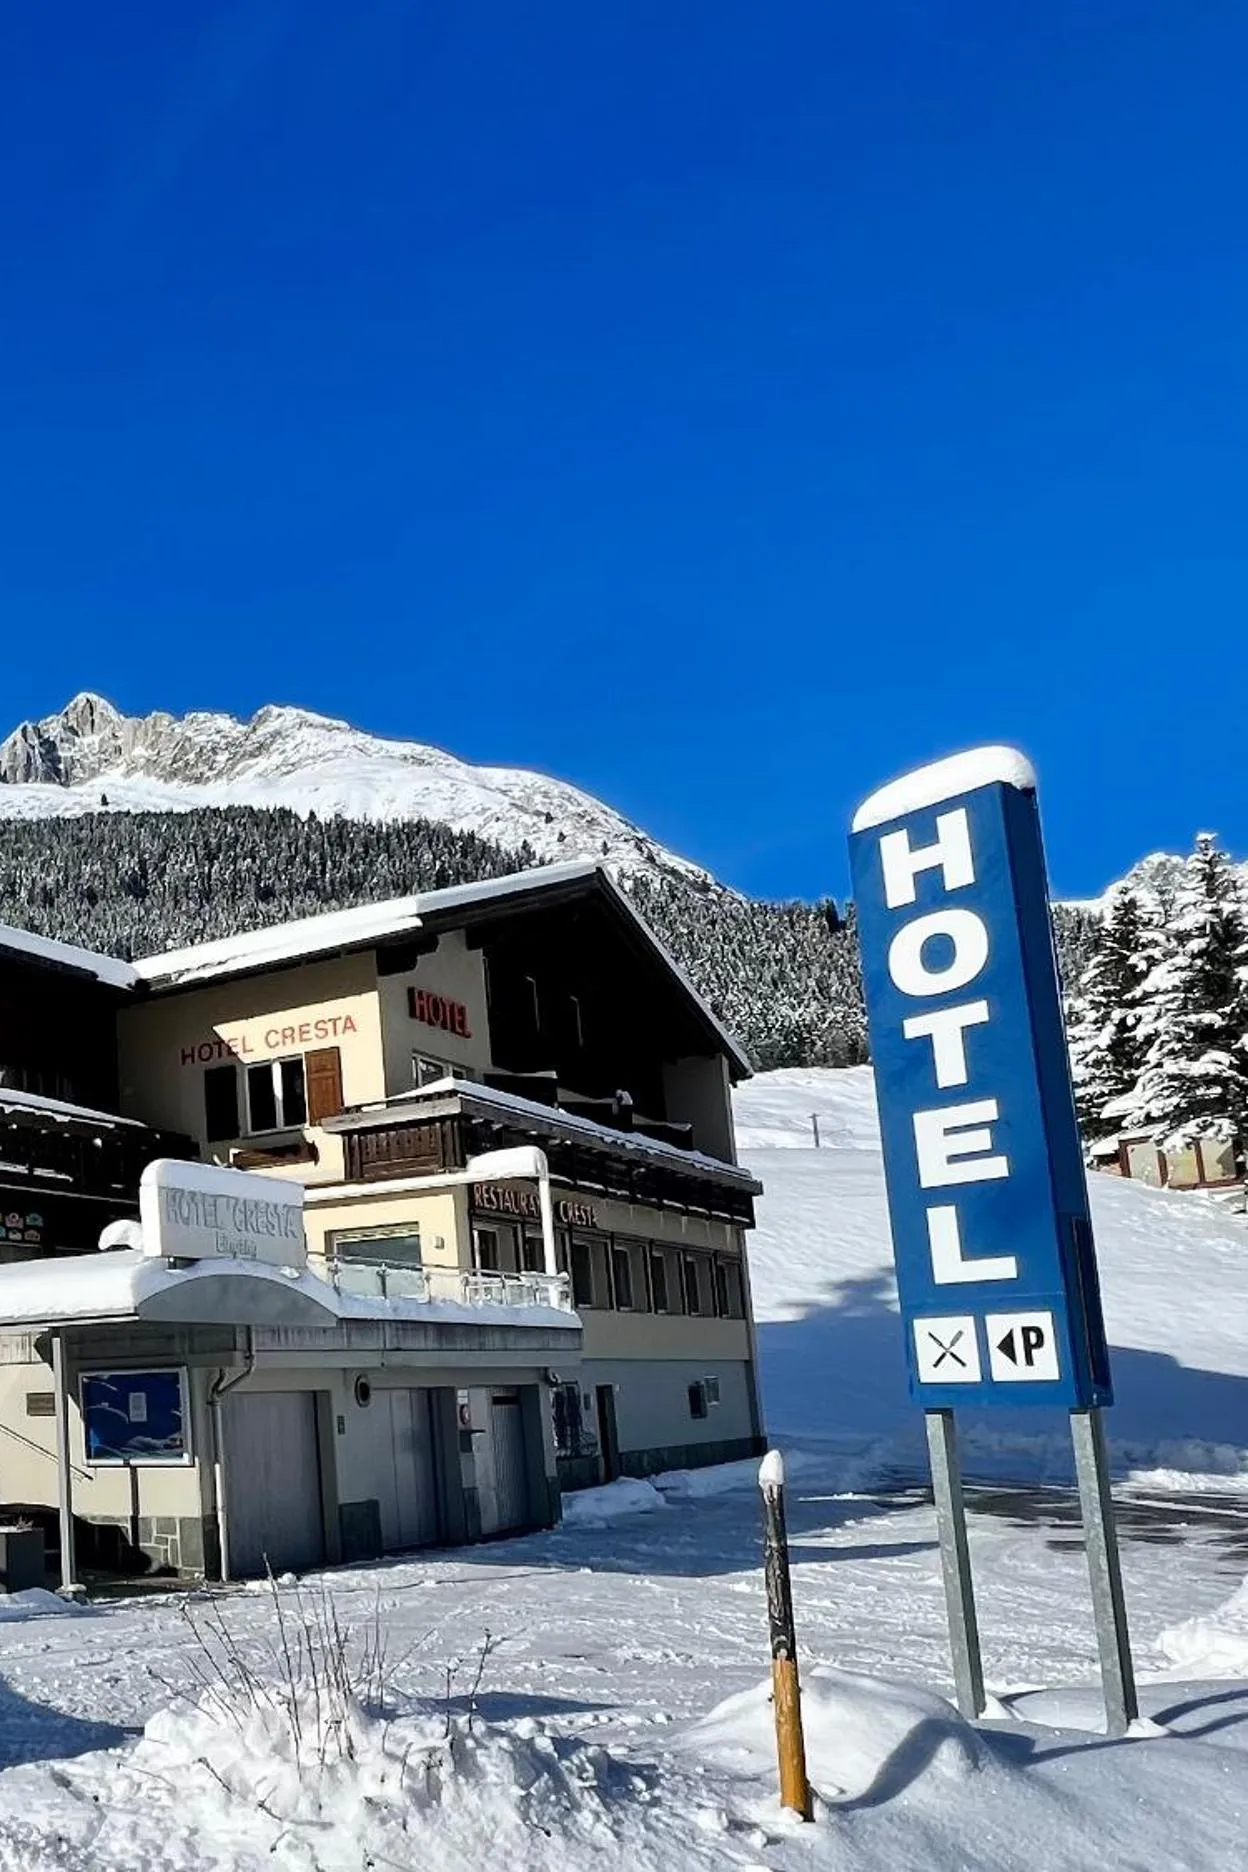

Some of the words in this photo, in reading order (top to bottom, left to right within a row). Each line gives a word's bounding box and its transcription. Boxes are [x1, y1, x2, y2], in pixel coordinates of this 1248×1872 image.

[409, 987, 473, 1038] HOTEL
[181, 1032, 254, 1066] HOTEL
[264, 1014, 358, 1048] CRESTA
[879, 806, 1019, 1286] HOTEL
[473, 1182, 541, 1217] RESTAURA
[559, 1200, 600, 1227] CRESTA
[1021, 1326, 1044, 1366] P
